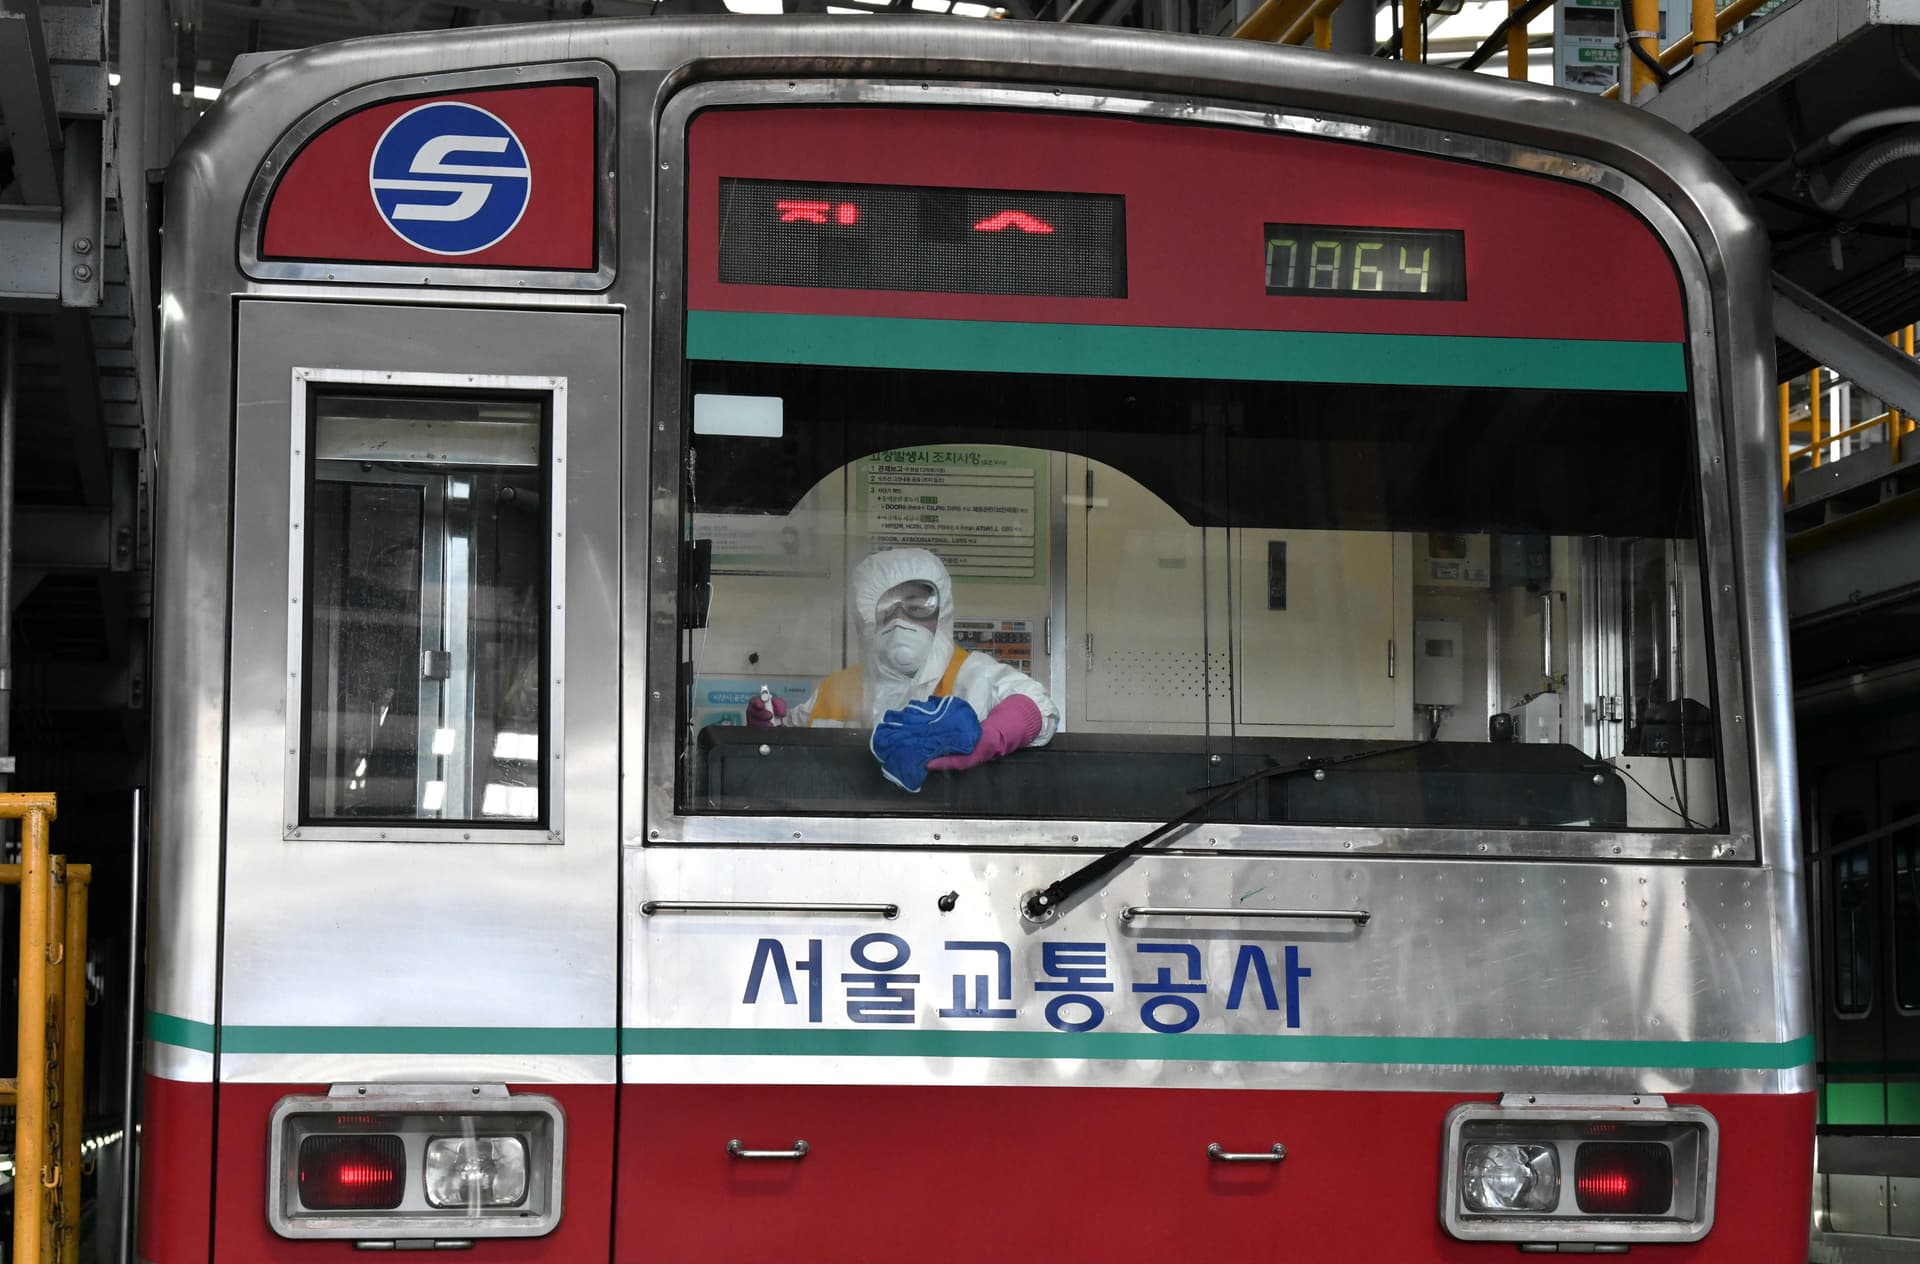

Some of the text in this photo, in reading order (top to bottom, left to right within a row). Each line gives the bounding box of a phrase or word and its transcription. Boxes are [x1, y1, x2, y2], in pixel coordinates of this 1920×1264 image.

[1265, 239, 1431, 293] 0864
[933, 452, 981, 465] 조치사항
[742, 932, 1312, 1034] 서울교통공사
